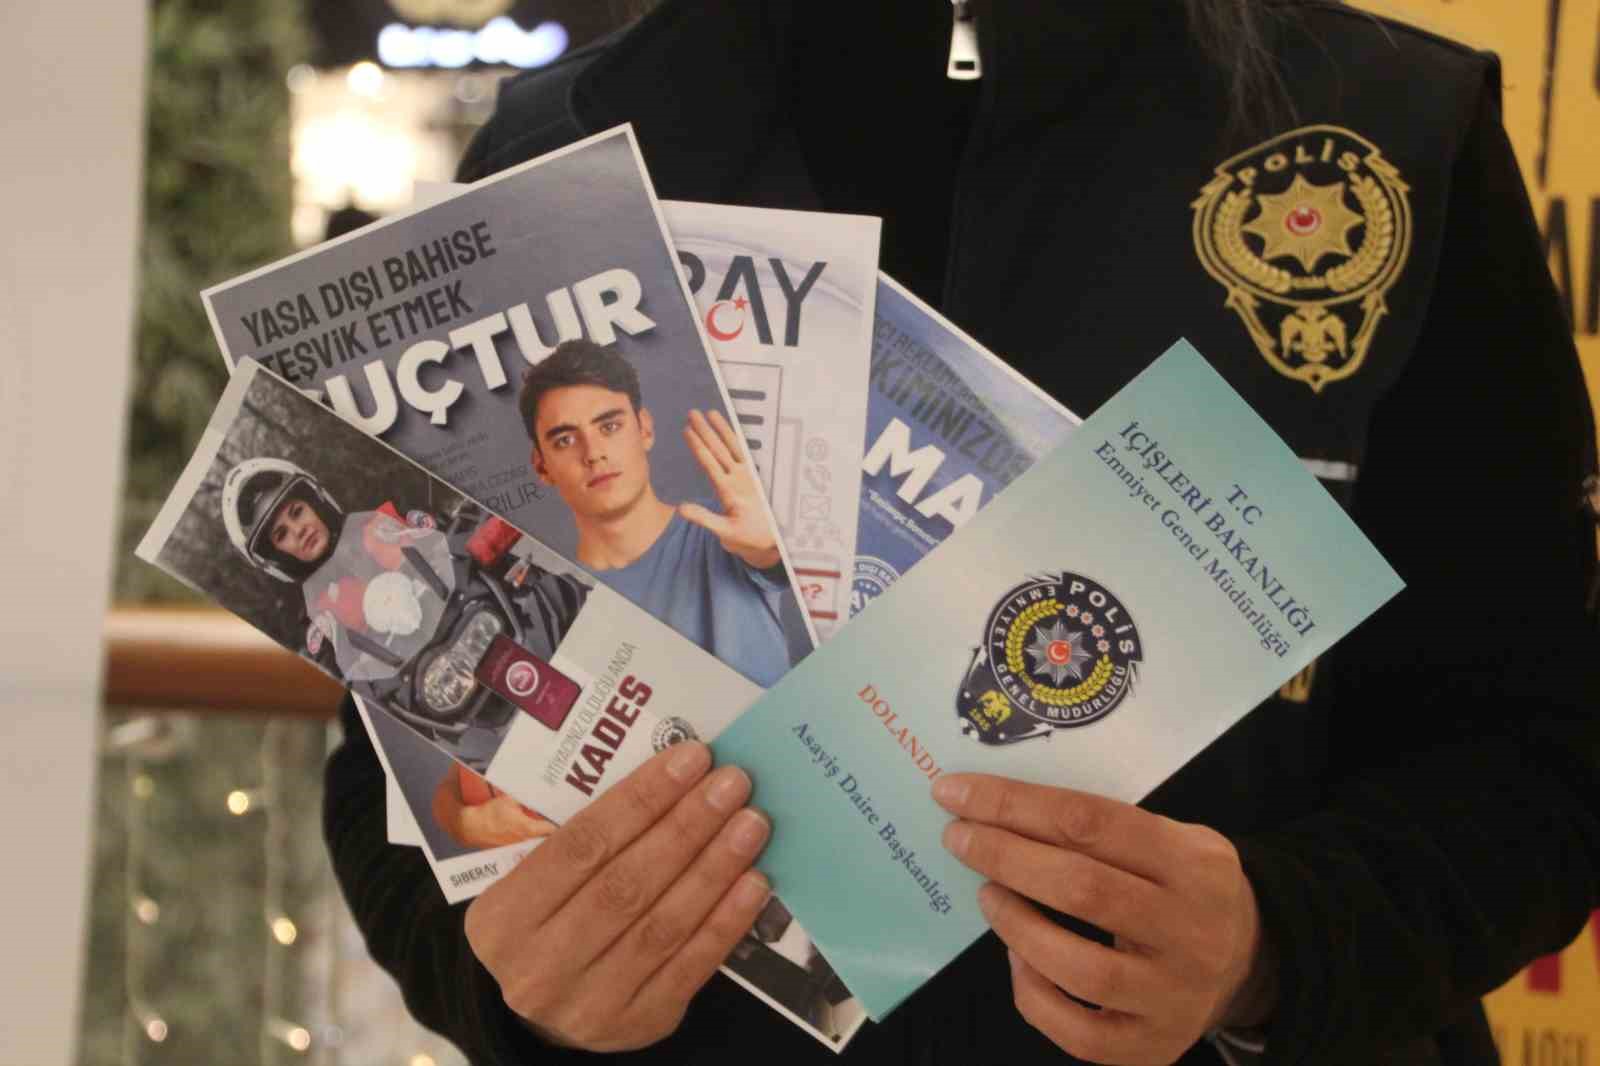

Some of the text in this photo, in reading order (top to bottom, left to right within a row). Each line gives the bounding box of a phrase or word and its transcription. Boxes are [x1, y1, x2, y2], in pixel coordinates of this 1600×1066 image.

[240, 221, 497, 348] YASA DIŞI BAHİSE
[366, 280, 473, 352] ETMEK
[303, 268, 657, 437] UÇTUR
[1093, 440, 1292, 659] Emniyet Genel Müdürlüğü
[1119, 421, 1316, 638] İÇİŞLERİ BAKANLIĞI
[1226, 484, 1264, 525] T.C
[1069, 580, 1135, 654] POLİS
[564, 673, 653, 797] KADES
[996, 663, 1037, 711] GENEL
[791, 721, 953, 917] Asayiş Daire Başkanlığı
